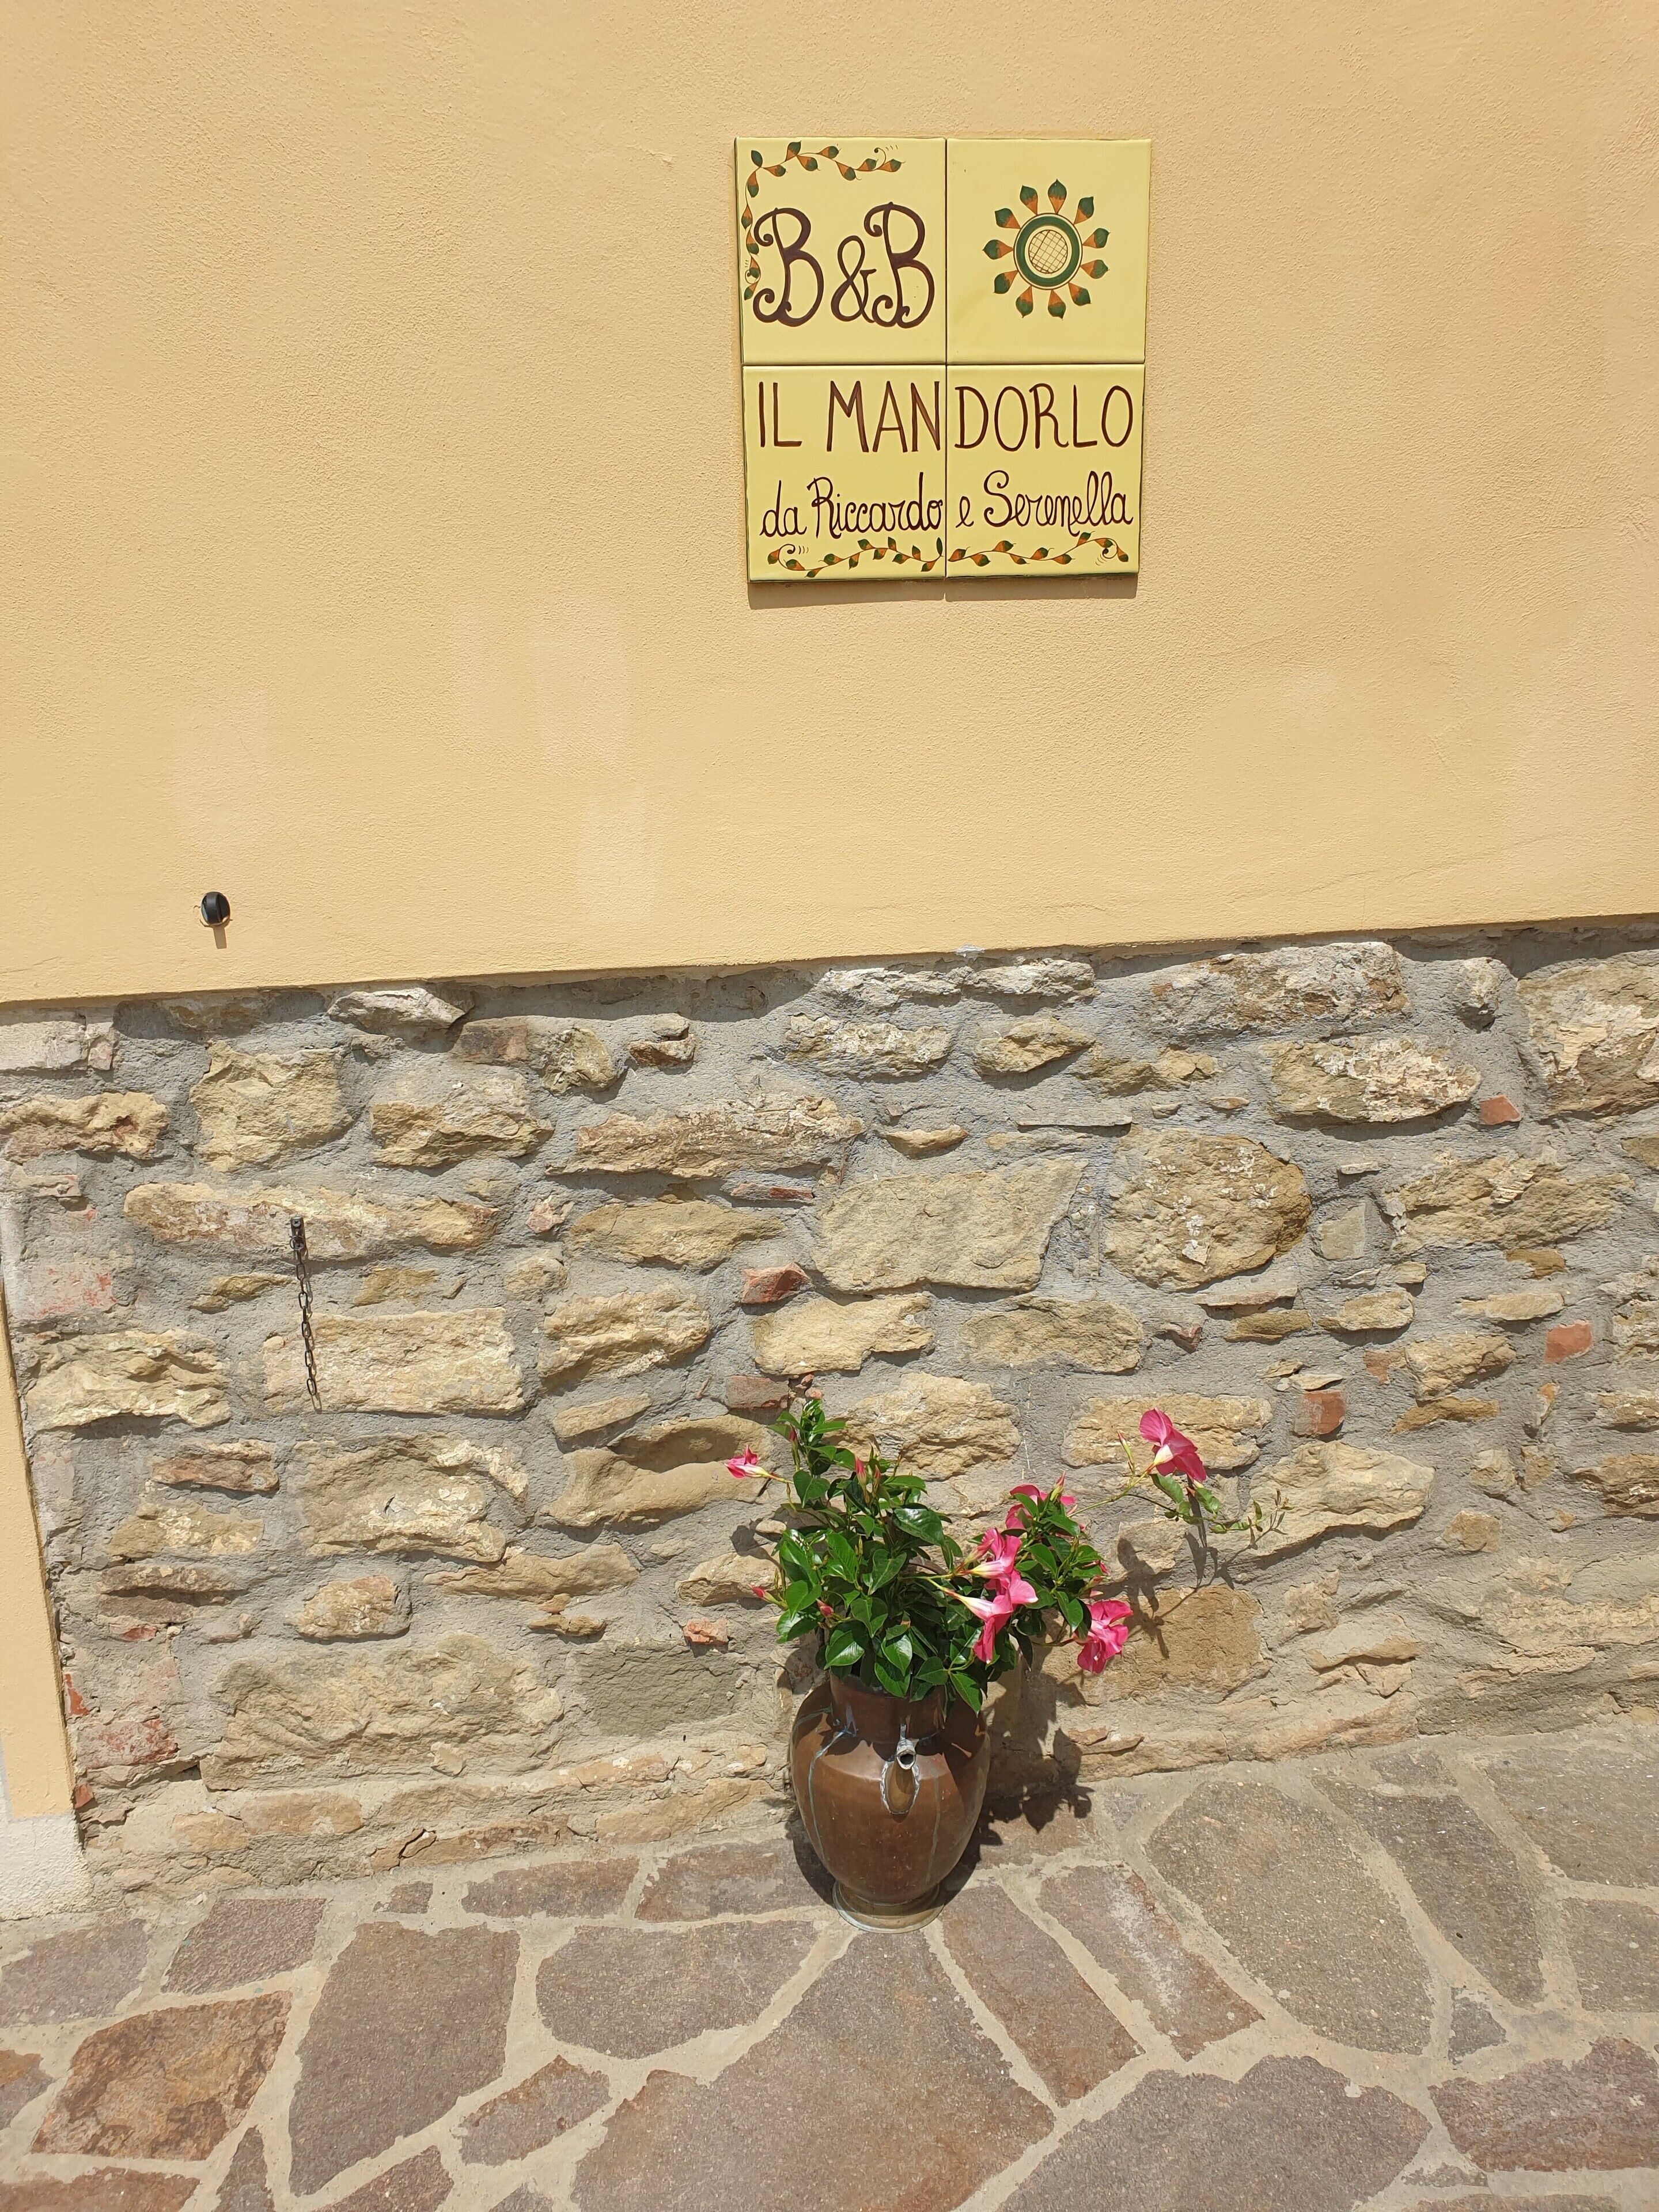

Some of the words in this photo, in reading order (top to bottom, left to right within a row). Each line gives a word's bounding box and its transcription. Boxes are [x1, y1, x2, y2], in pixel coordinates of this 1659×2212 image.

[753, 202, 935, 328] B&B
[759, 381, 802, 448] IL
[826, 381, 1133, 453] MANDORLO
[759, 480, 807, 537] da
[806, 472, 944, 539] Riccardo
[956, 495, 974, 528] e
[983, 470, 1133, 536] Serenella
